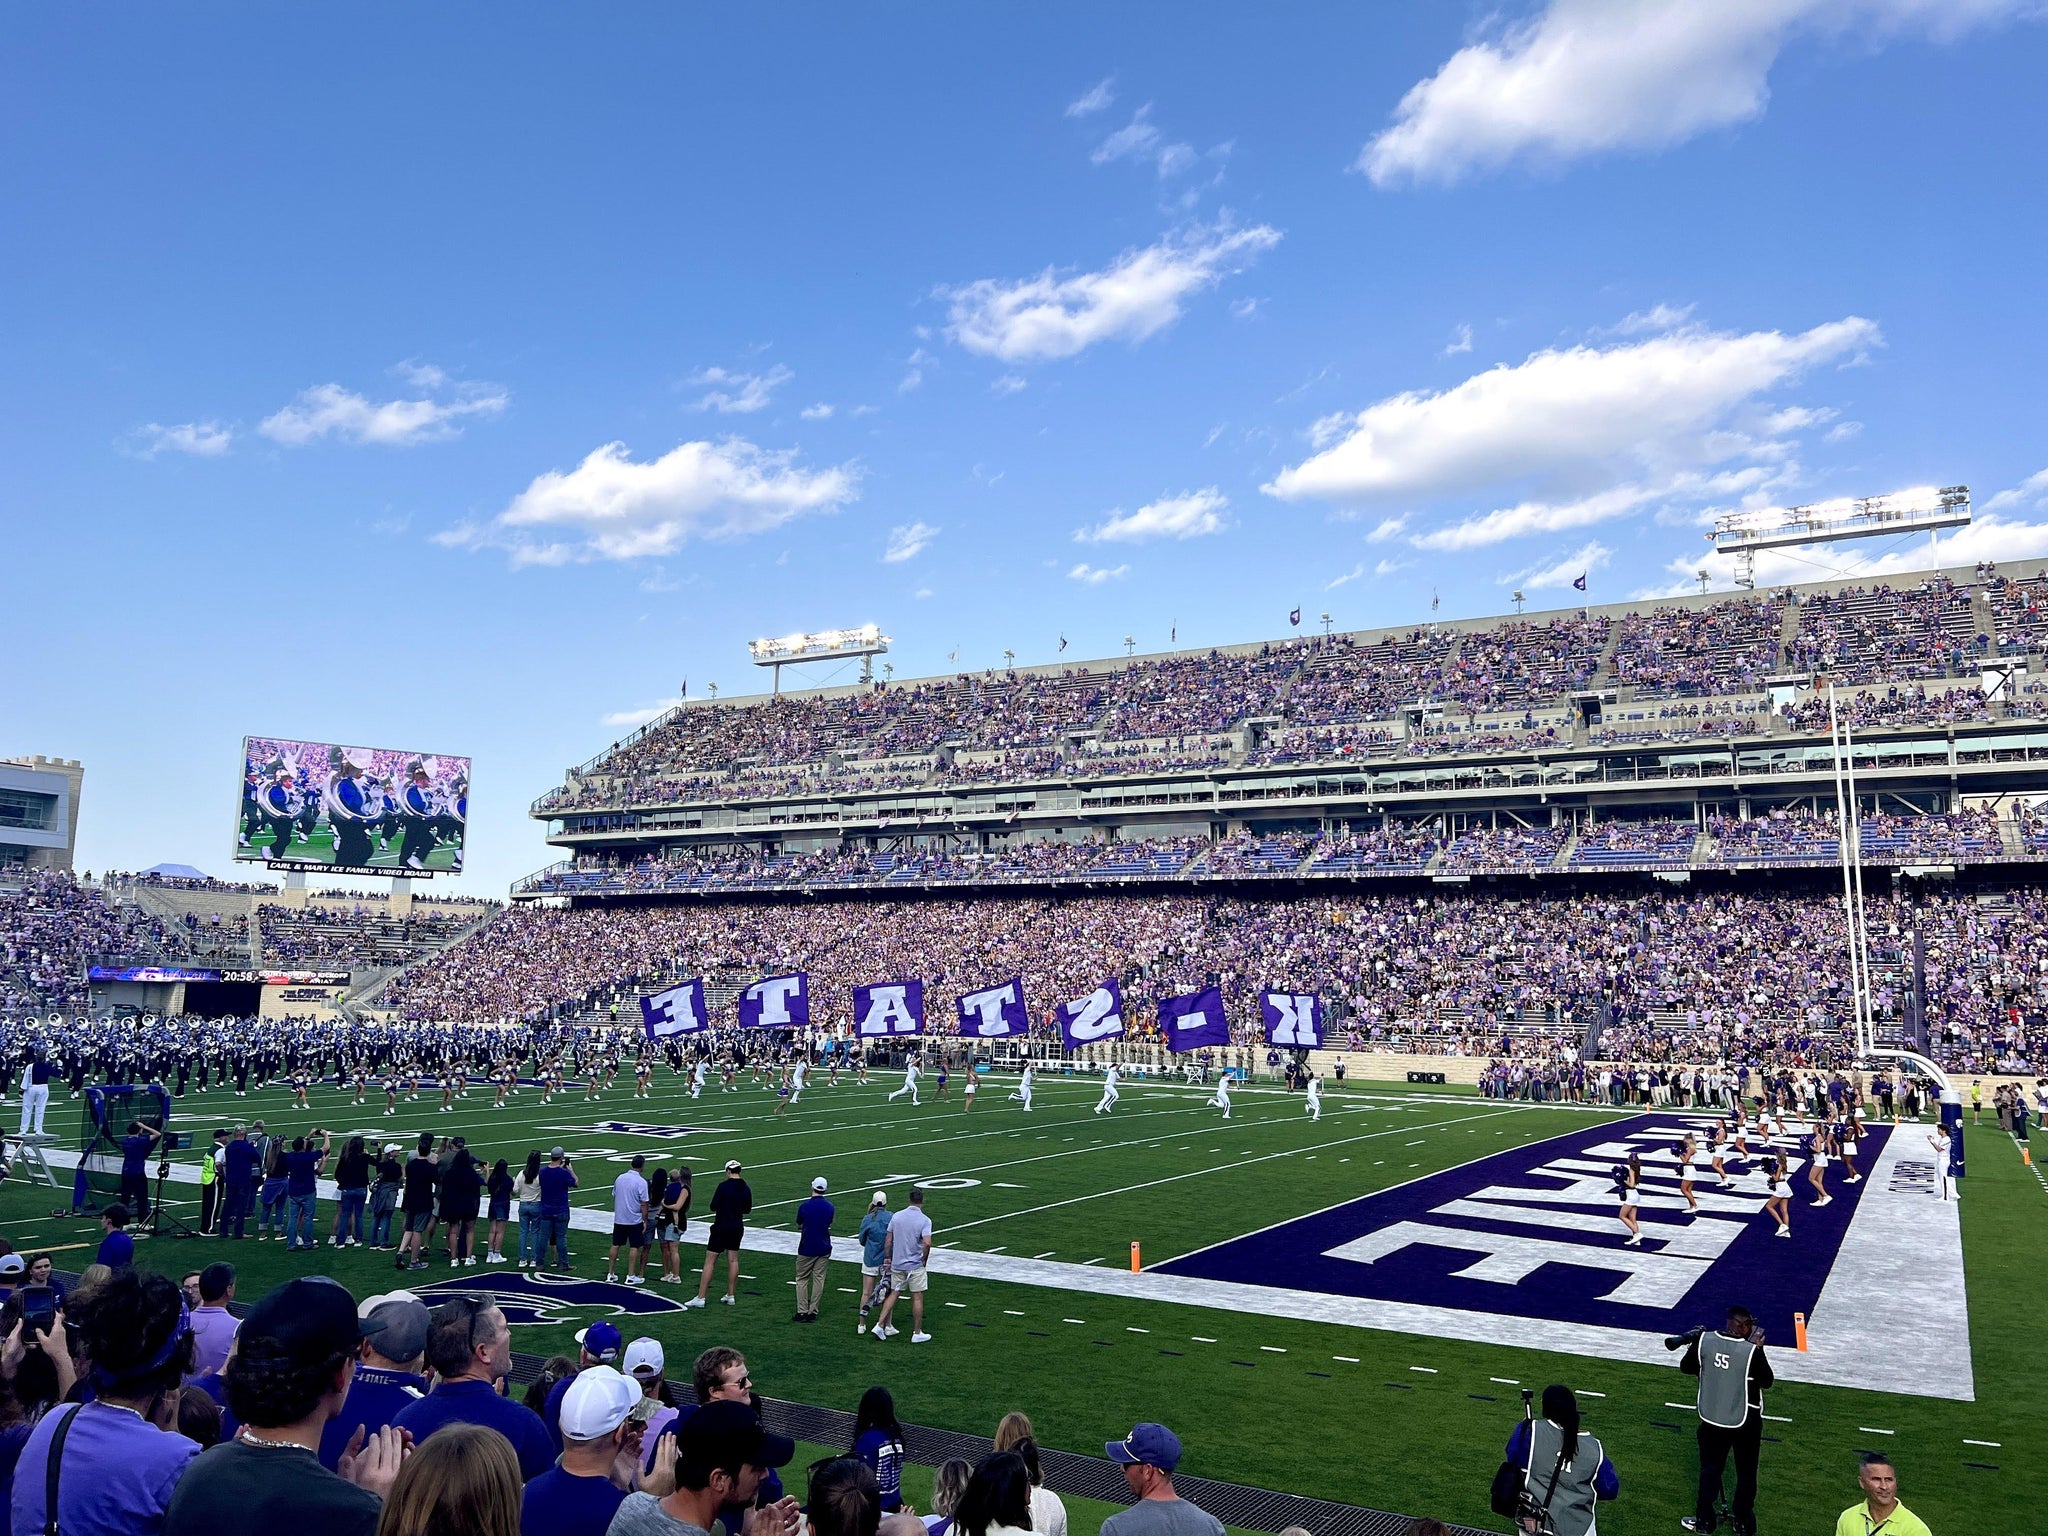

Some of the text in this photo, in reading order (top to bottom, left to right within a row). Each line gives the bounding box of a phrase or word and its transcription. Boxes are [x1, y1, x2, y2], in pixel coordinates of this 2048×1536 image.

[1769, 860, 1810, 868] DARREN
[1952, 856, 1986, 864] JORDY
[345, 866, 375, 874] FAMILY
[378, 868, 402, 876] VIDEO
[1484, 867, 1536, 875] GRAMATICA
[1647, 863, 1691, 871] NEWMAN
[1358, 870, 1391, 878] SNYDER
[224, 971, 253, 981] 20:58
[1713, 1352, 1731, 1370] 55
